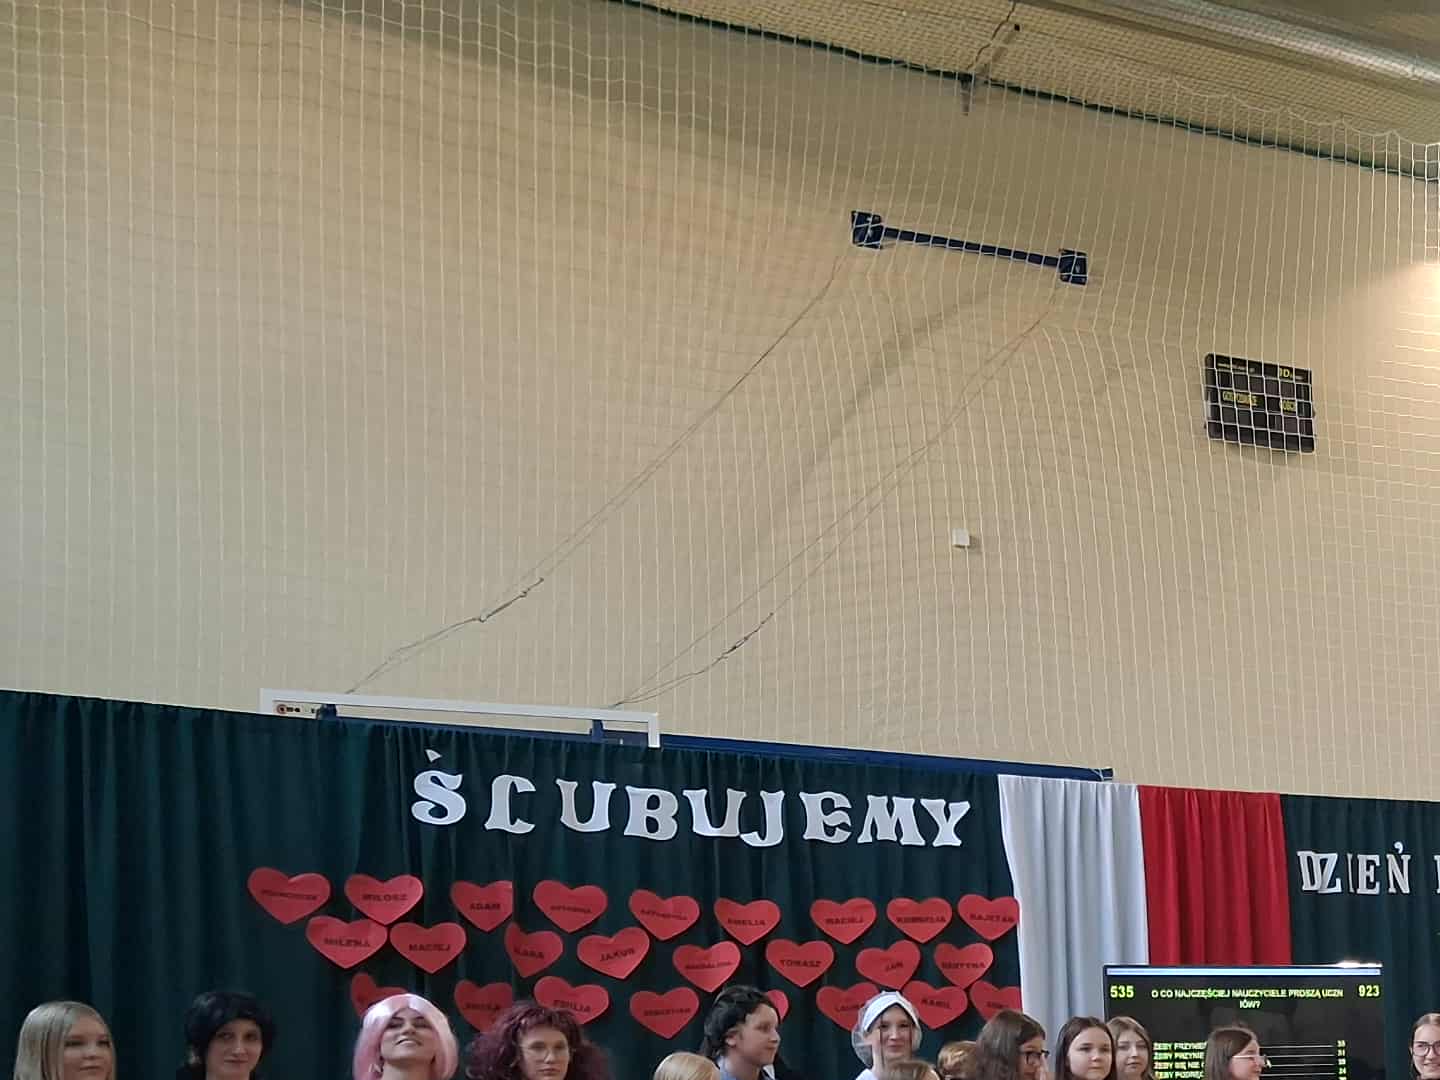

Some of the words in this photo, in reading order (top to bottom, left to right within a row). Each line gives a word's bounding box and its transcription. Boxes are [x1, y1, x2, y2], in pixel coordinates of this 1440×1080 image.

[1151, 989, 1159, 998] O
[1160, 989, 1173, 998] CO
[1358, 985, 1380, 997] 923
